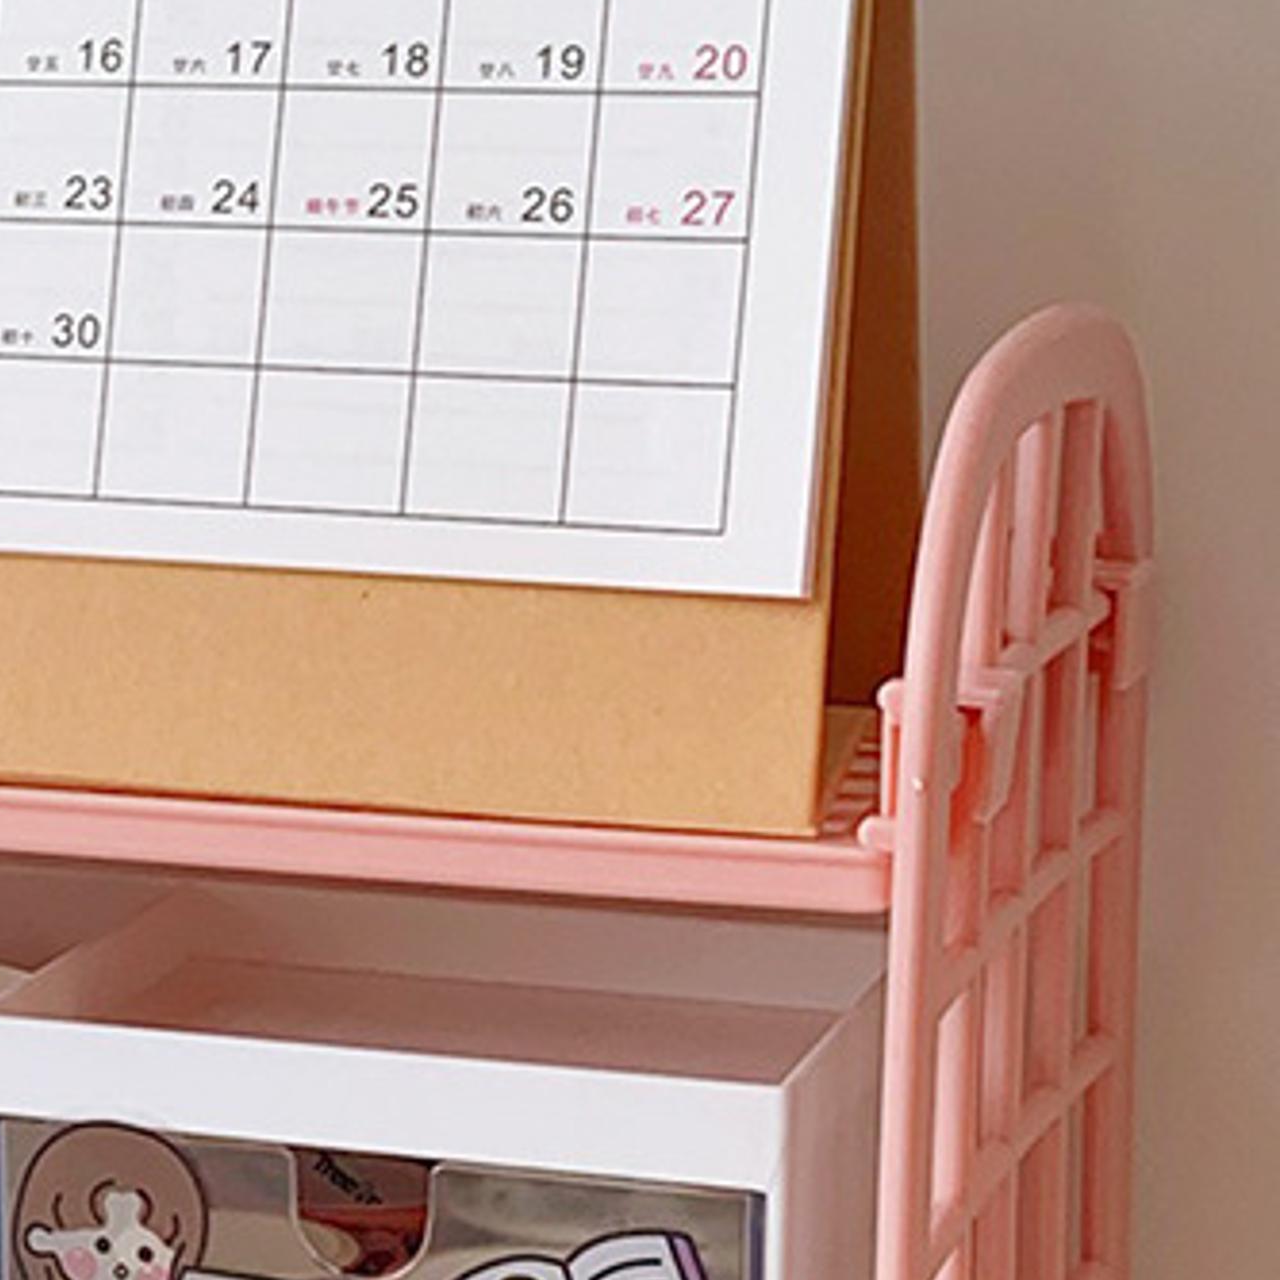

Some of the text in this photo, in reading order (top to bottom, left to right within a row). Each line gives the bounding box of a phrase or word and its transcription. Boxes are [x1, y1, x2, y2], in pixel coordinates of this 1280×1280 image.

[80, 37, 123, 74] 16
[227, 40, 272, 74] 17
[383, 41, 429, 79] 18
[537, 44, 586, 81] 19
[693, 43, 748, 81] 20
[63, 174, 113, 211] 23
[211, 179, 259, 215] 24
[366, 182, 419, 219] 25
[521, 186, 574, 224] 26
[680, 189, 736, 227] 27
[51, 312, 101, 350] 30
